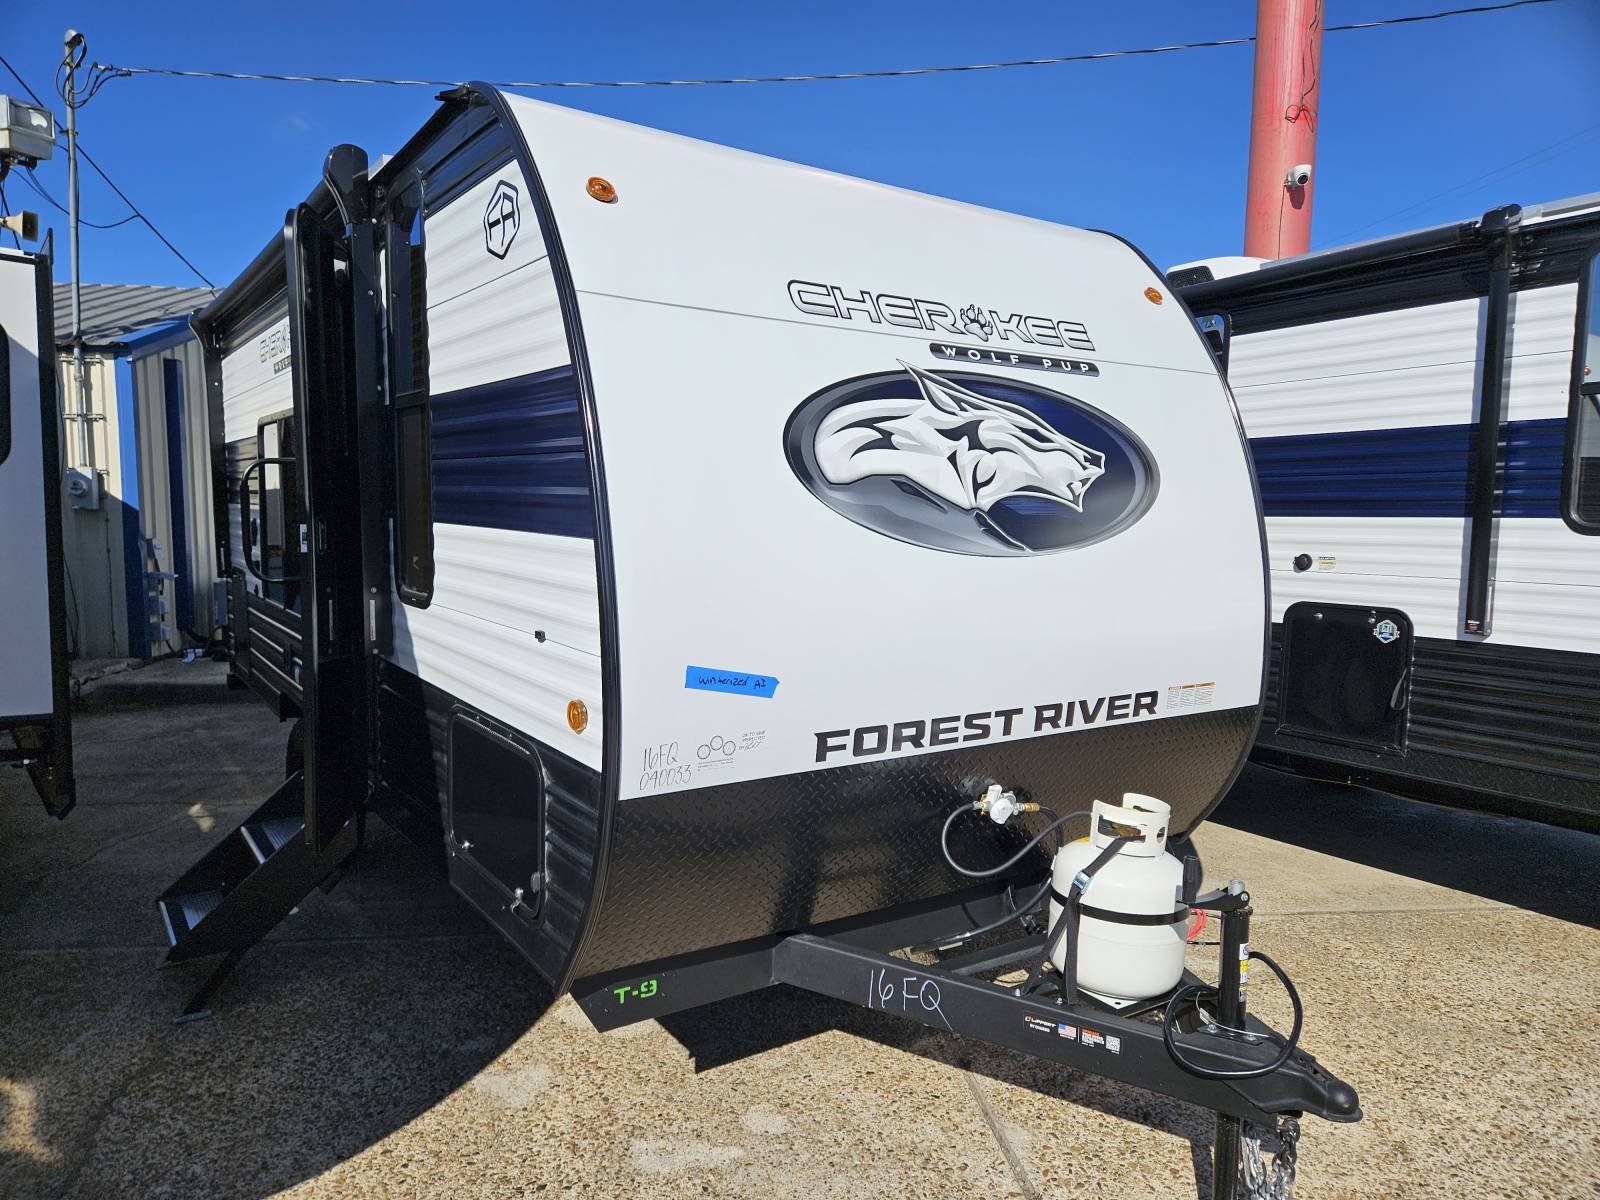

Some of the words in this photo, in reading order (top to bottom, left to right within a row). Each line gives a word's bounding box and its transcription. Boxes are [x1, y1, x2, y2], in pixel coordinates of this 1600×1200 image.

[941, 345, 1020, 365] WOLF
[1042, 357, 1089, 373] PUP
[813, 707, 1024, 763] FOREST
[1033, 689, 1159, 733] RIVER
[643, 741, 679, 771] 16FQ
